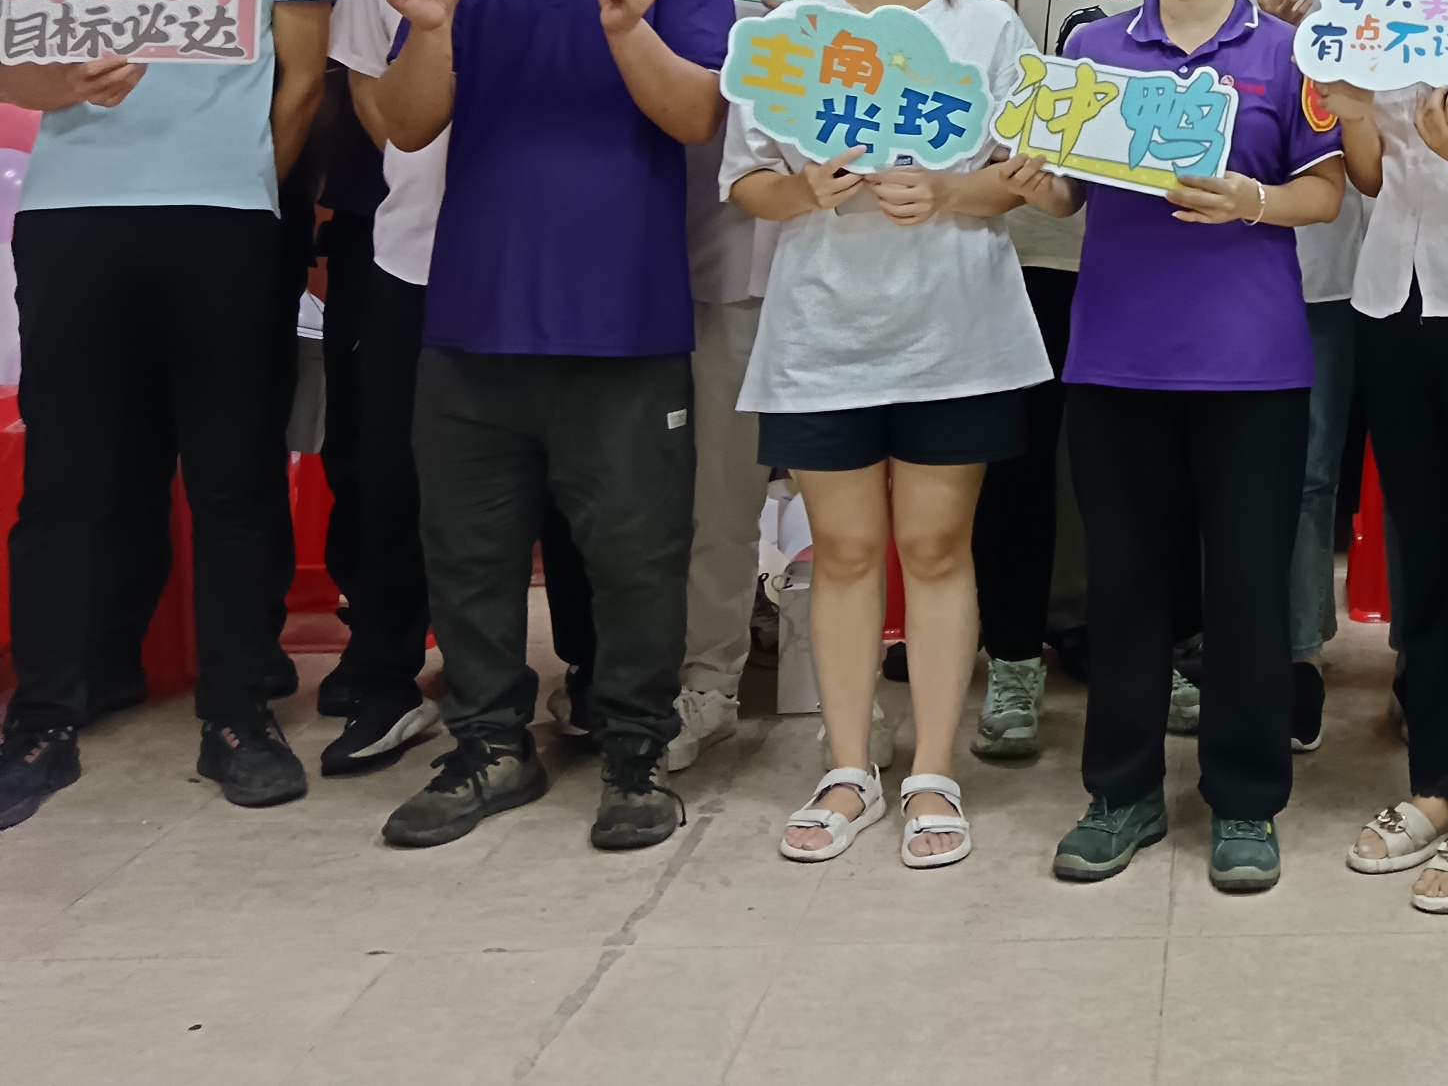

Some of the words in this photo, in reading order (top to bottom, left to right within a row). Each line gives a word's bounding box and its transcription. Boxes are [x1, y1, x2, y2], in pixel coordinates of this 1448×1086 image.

[4, 2, 245, 58] 目标必达
[741, 29, 885, 96] 主角
[815, 88, 973, 154] 光环
[995, 54, 1228, 178] 冲鸭
